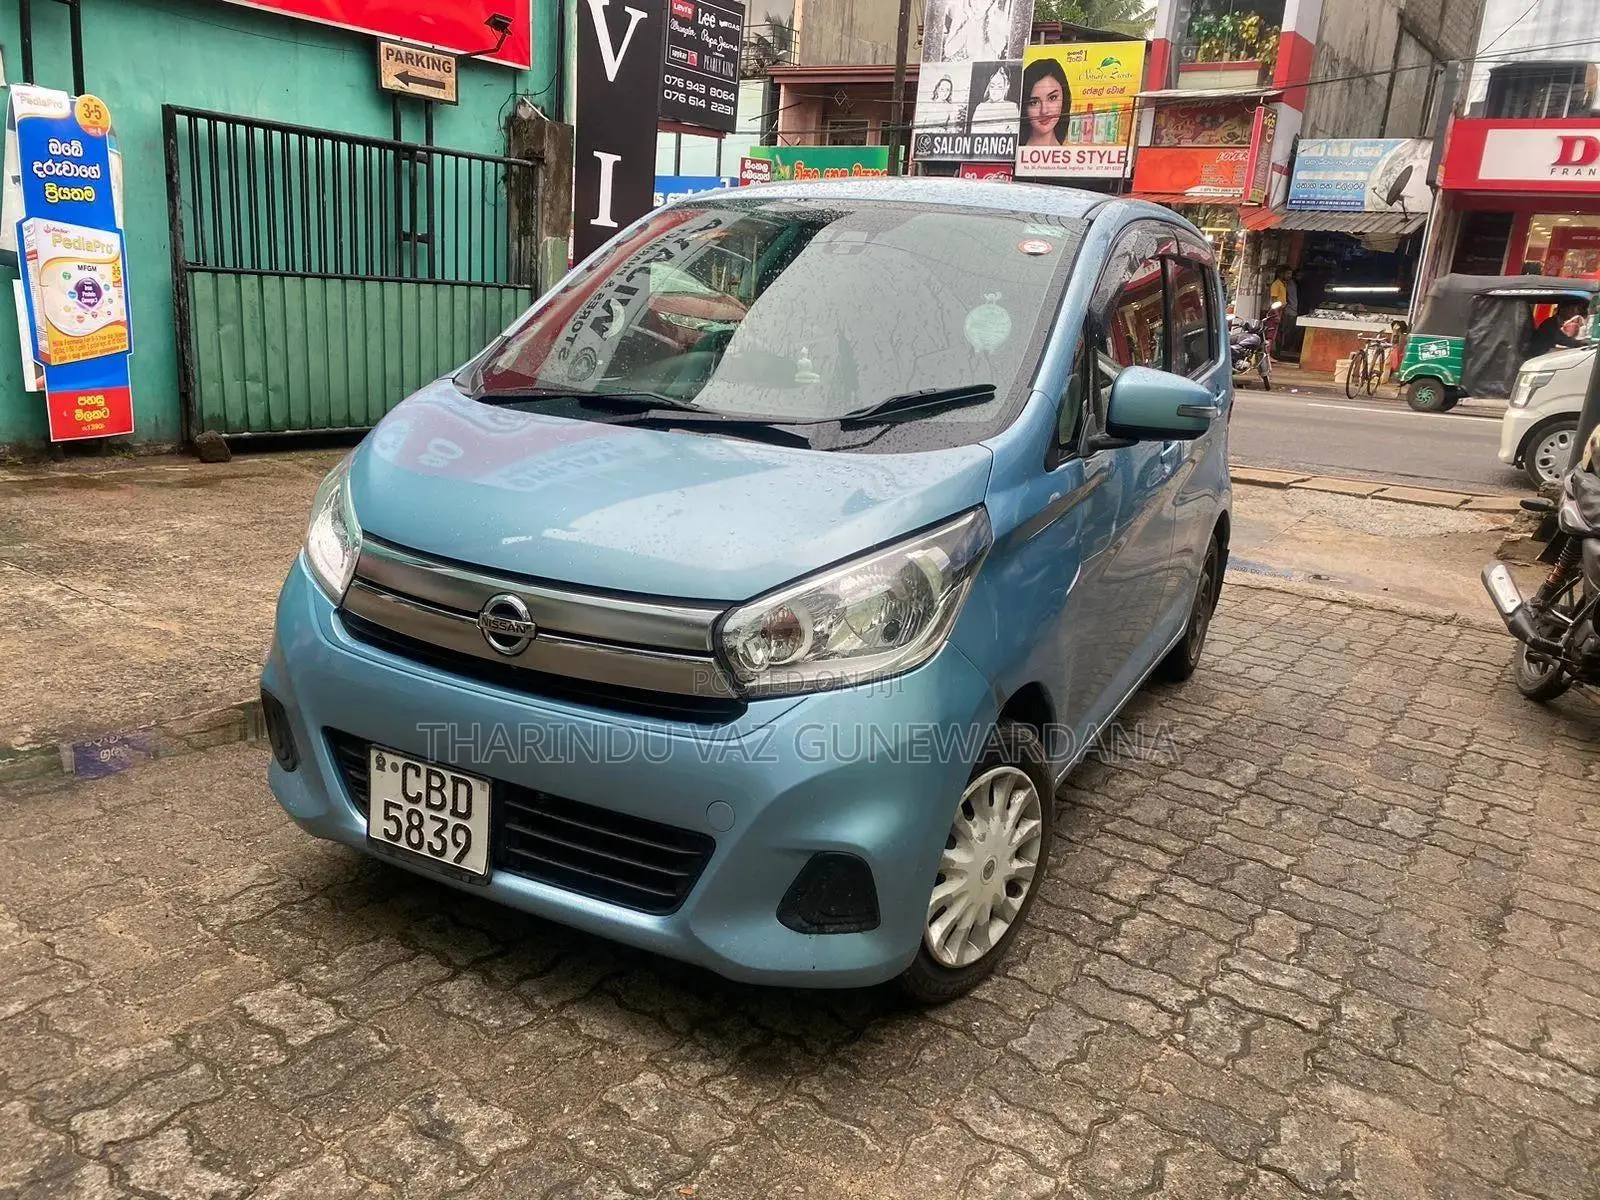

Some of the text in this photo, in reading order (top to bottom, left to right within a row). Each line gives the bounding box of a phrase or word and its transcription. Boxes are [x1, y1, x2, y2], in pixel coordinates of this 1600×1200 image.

[697, 8, 716, 28] Lee
[385, 47, 452, 73] PARKING
[664, 74, 735, 102] 076 943 8064
[83, 103, 102, 120] 3-5
[663, 89, 734, 115] 076 614 2231
[48, 138, 83, 157] ඔබේ
[933, 136, 1014, 154] SALON GANGA
[1021, 150, 1127, 164] LOVES STYLE
[33, 158, 101, 179] දරුවාගේ
[45, 183, 96, 203] ප්‍රියතම
[51, 233, 114, 254] PediaPro
[480, 615, 527, 634] NISSAN
[402, 761, 473, 820] CBD
[383, 799, 472, 864] 5839
